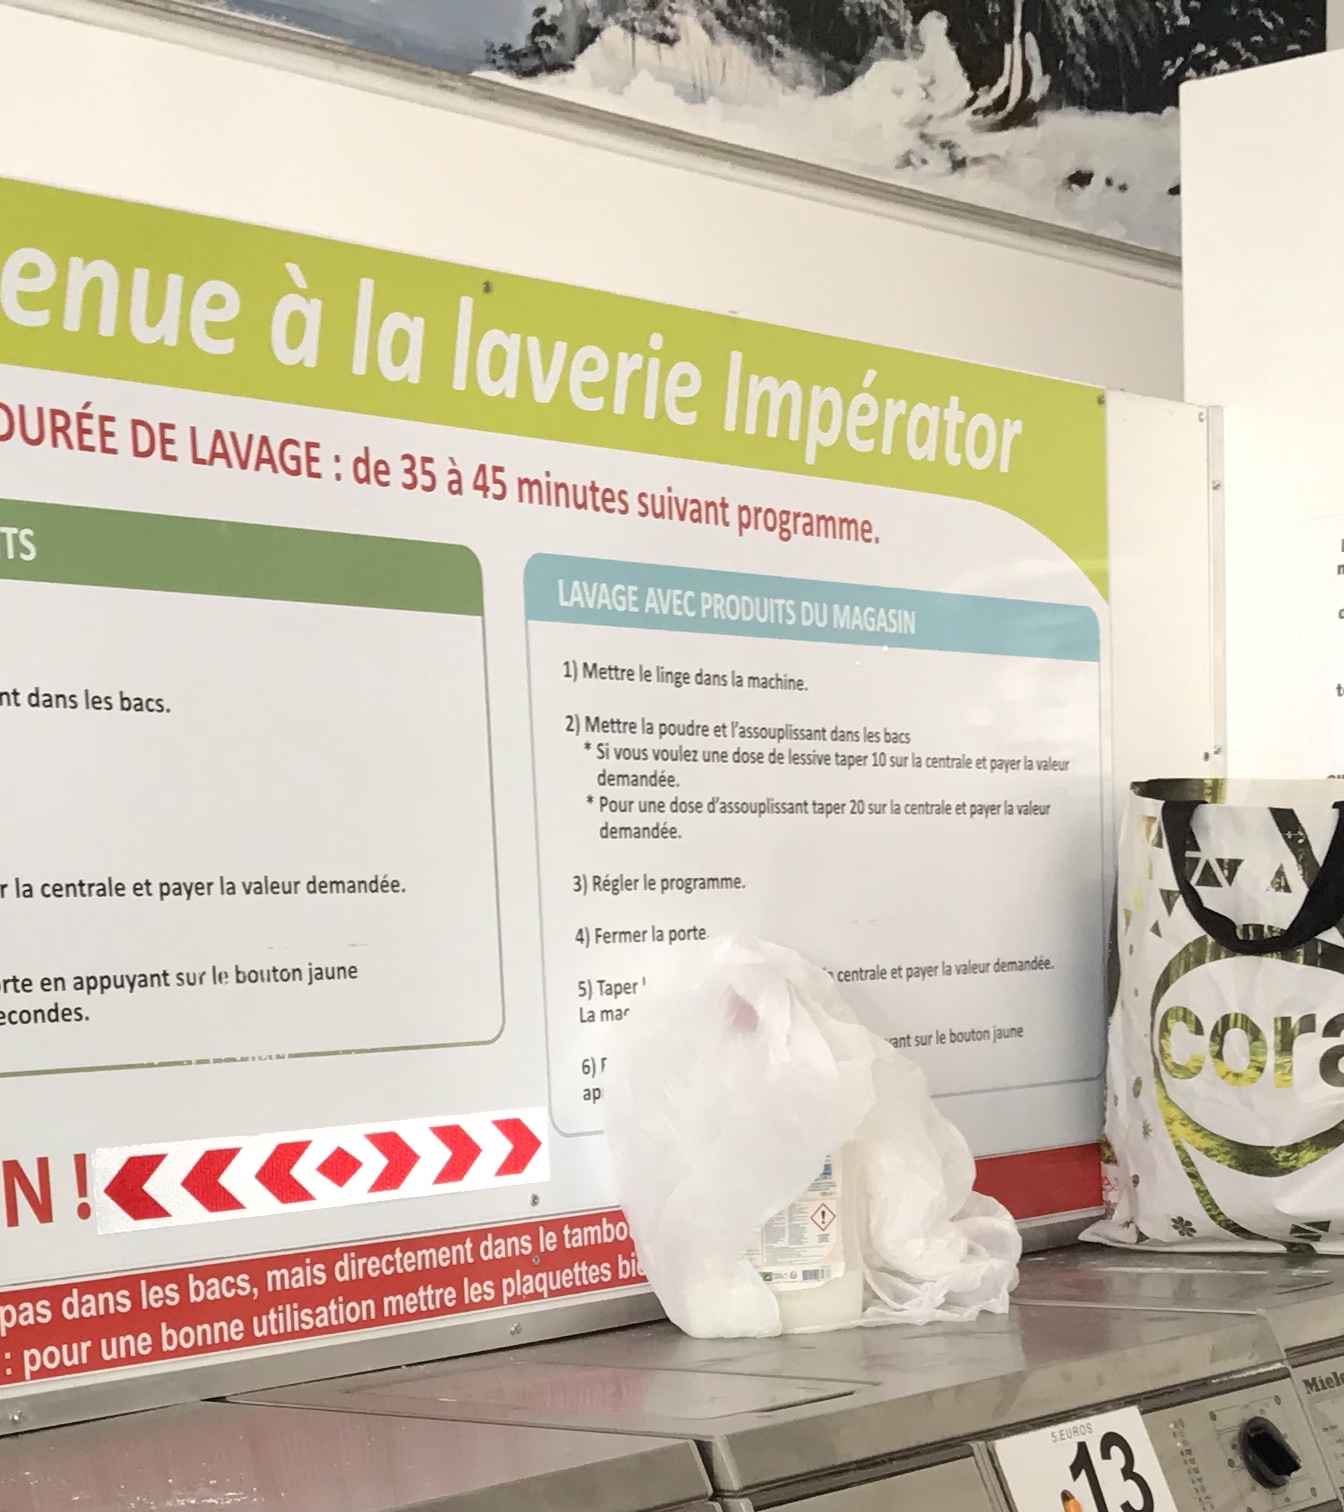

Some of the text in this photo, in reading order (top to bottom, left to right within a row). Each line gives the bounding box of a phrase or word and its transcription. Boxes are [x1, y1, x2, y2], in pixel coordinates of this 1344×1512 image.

[271, 263, 322, 368] à
[352, 278, 424, 384] la
[452, 296, 701, 425] laverie
[724, 350, 1022, 472] Impérator
[131, 419, 177, 462] DE
[190, 426, 322, 478] LAVAGE
[353, 446, 390, 487] de
[401, 454, 436, 492] 35
[448, 457, 462, 496] à
[473, 464, 506, 500] 45
[518, 471, 628, 515] minutes
[638, 486, 730, 527] suivant
[738, 505, 879, 544] programme.
[558, 579, 915, 634] LAVAGE AVEC PRODUITS DU MAGASIN
[28, 687, 78, 709] dans
[85, 689, 112, 710] les
[120, 691, 170, 713] bacs.
[564, 660, 808, 691] 1) Mettre le linge dans la machine.
[15, 878, 33, 898] la
[41, 877, 125, 898] centrale
[133, 879, 152, 896] et
[159, 882, 214, 901] payer
[220, 876, 236, 895] la
[242, 876, 300, 895] valeur
[306, 874, 405, 894] demandée.
[0, 1300, 52, 1334] pas
[62, 1288, 131, 1320] dans
[141, 1280, 179, 1309] les
[189, 1274, 258, 1302] bacs,
[267, 1264, 326, 1291] mais
[335, 1238, 474, 1282] directement
[480, 1233, 532, 1260] dans
[539, 1226, 557, 1252] le
